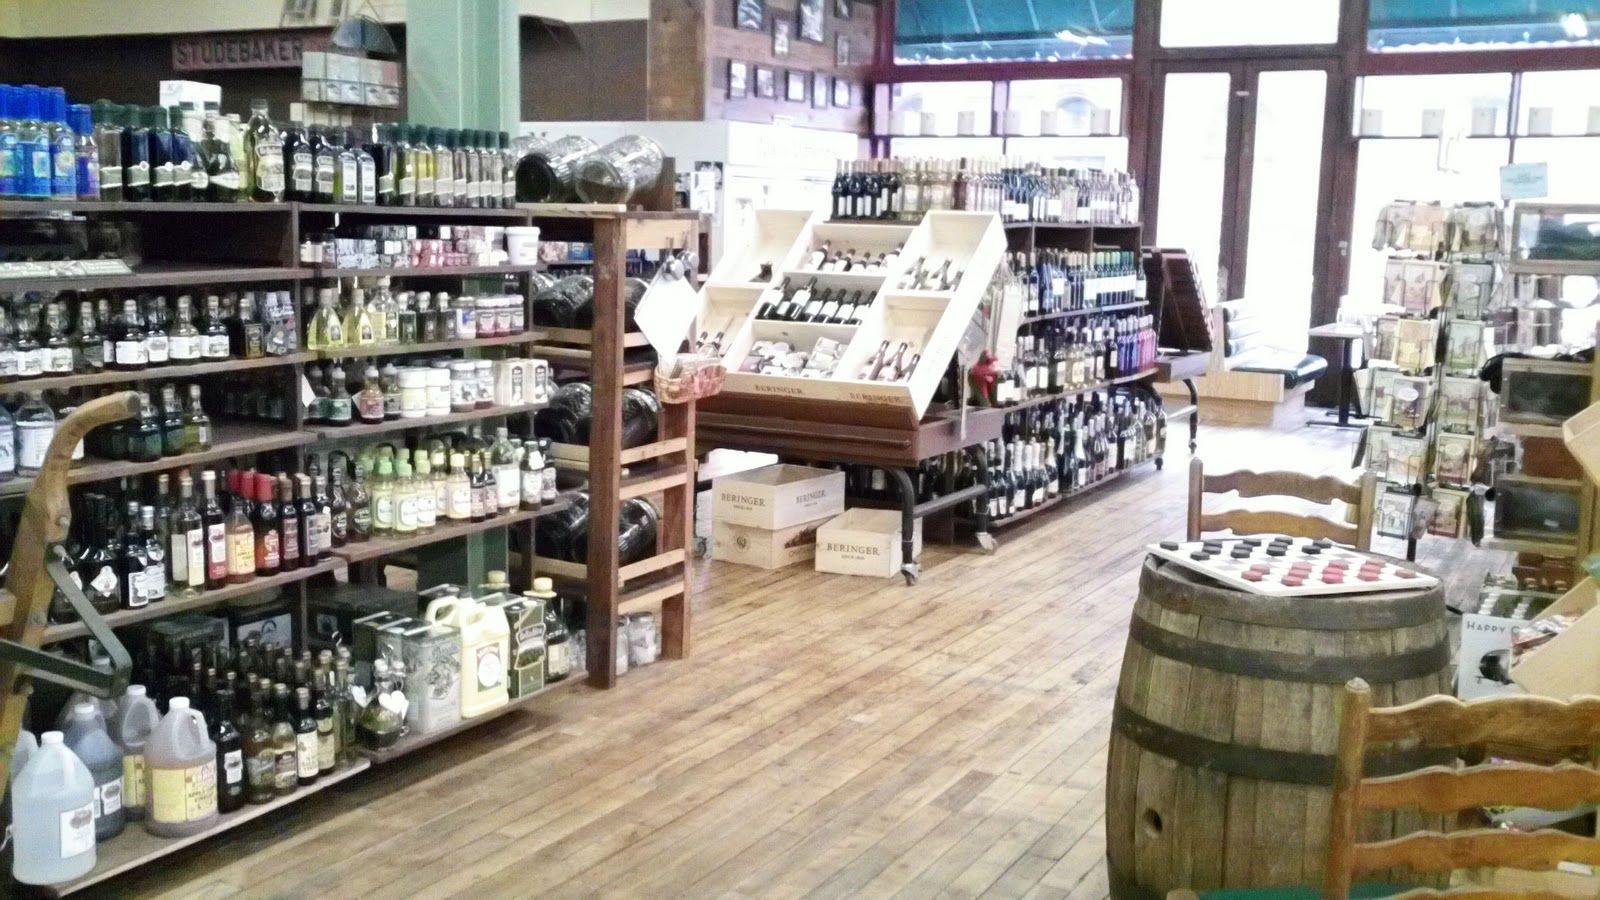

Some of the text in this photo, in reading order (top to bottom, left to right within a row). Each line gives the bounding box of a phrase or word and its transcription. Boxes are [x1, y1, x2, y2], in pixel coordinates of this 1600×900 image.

[174, 40, 300, 64] STUDEBAKER
[754, 384, 803, 395] BERINGER
[850, 392, 900, 402] BERINGER
[721, 493, 766, 506] BERINGER
[796, 489, 826, 503] BERINGER
[826, 542, 880, 556] BERINGER
[1466, 621, 1506, 632] HAPPY
